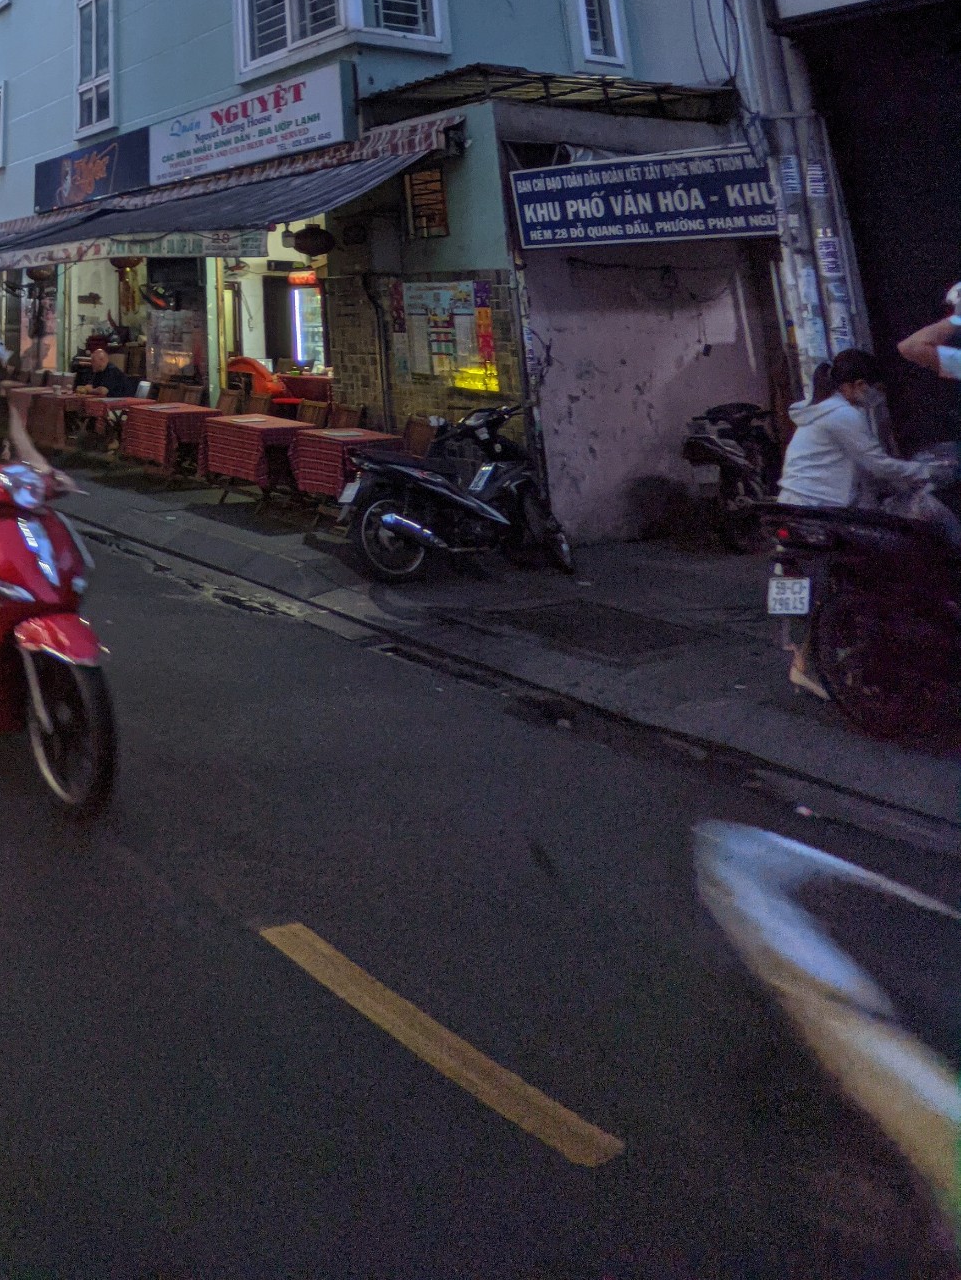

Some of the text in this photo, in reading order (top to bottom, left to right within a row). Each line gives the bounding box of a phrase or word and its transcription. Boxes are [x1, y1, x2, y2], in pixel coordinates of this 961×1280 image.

[210, 81, 307, 130] NGUYỆT
[247, 114, 273, 129] House
[523, 203, 562, 223] KHU
[565, 191, 606, 220] PHỐ
[609, 189, 653, 216] VĂN
[658, 183, 706, 213] HÓA
[554, 227, 568, 239] 28
[587, 223, 624, 239] QUANG
[655, 215, 706, 233] PHƯỜNG
[708, 214, 748, 232] PHẠM
